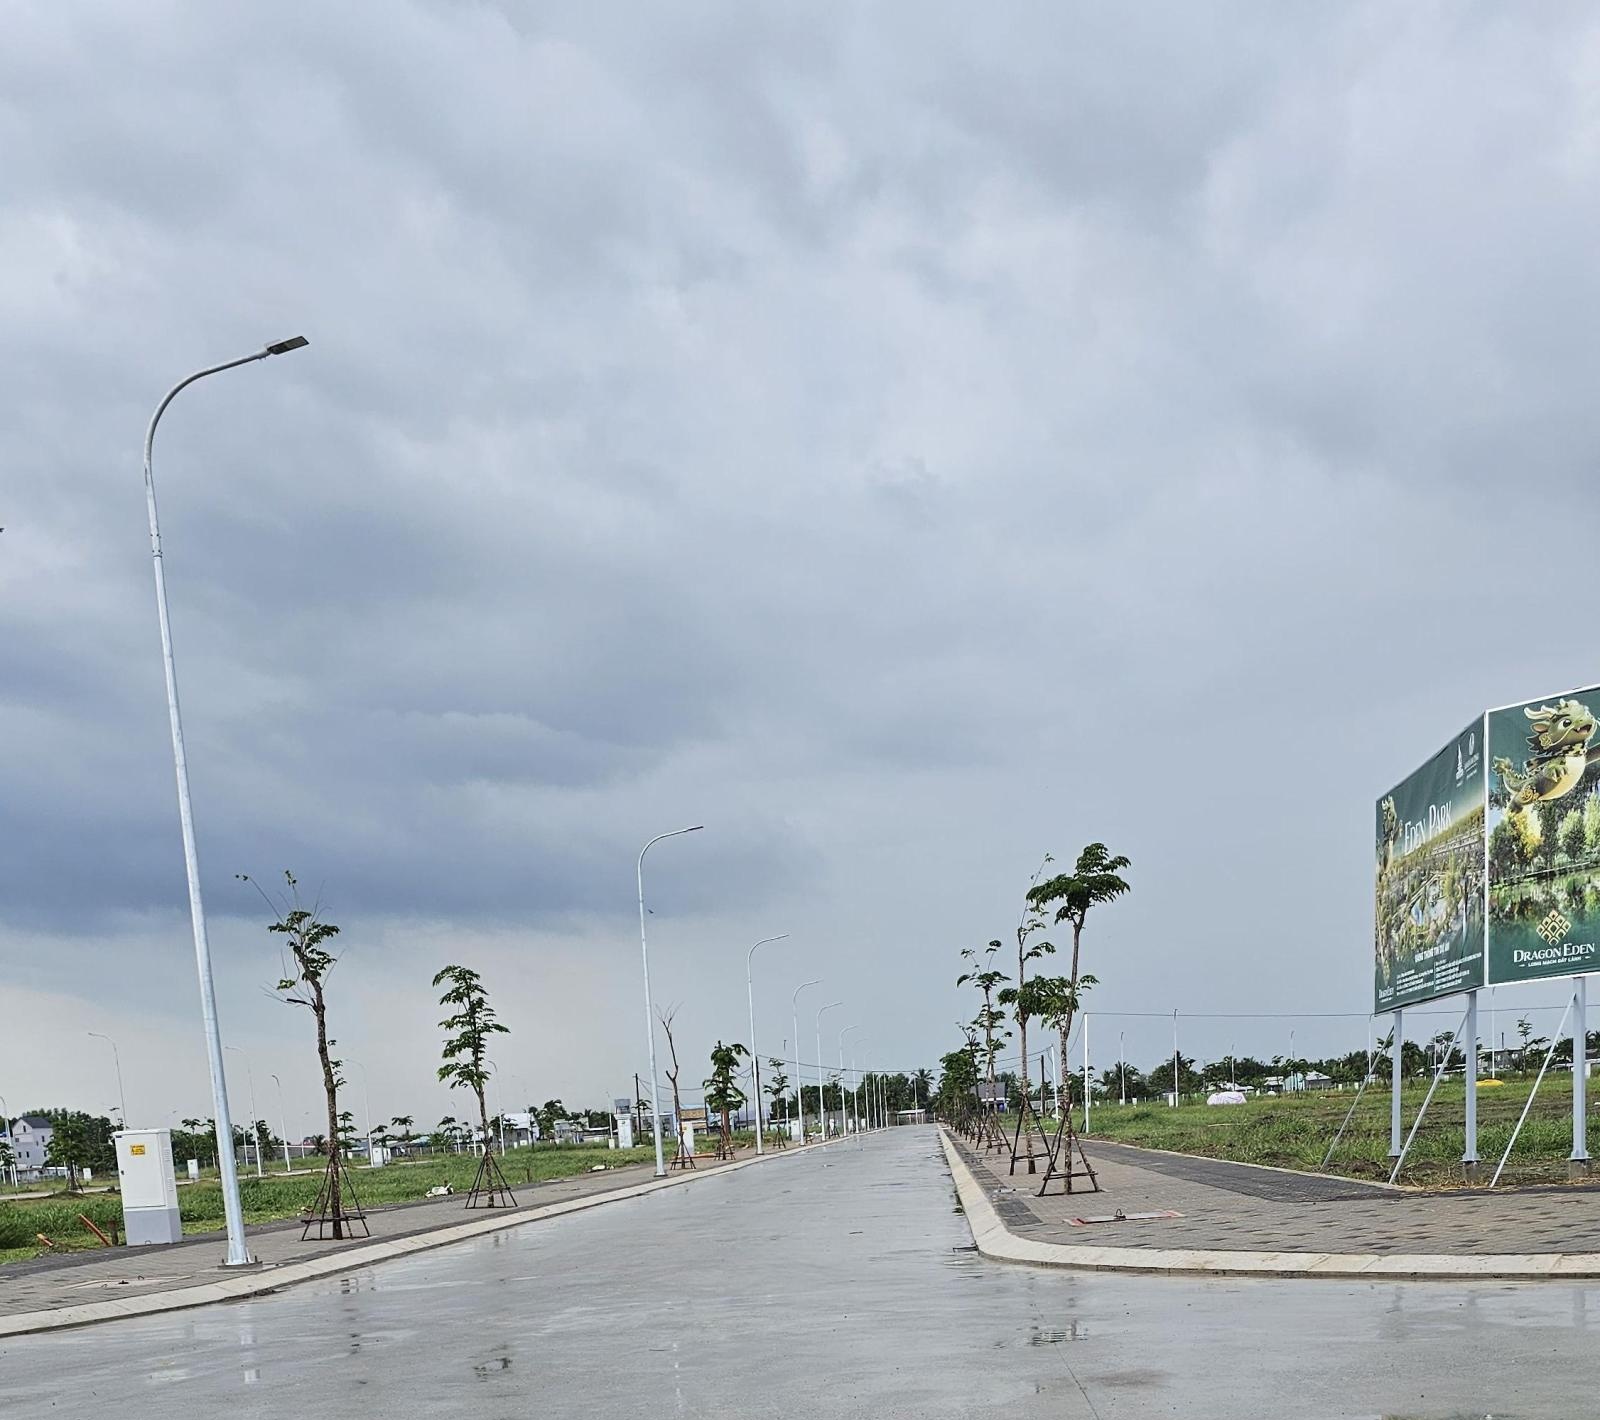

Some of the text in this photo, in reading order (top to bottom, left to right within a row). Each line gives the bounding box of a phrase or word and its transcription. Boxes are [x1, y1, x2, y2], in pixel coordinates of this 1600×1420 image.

[1405, 800, 1452, 856] EDEN PARK
[1513, 943, 1595, 963] DRAGON EDEN
